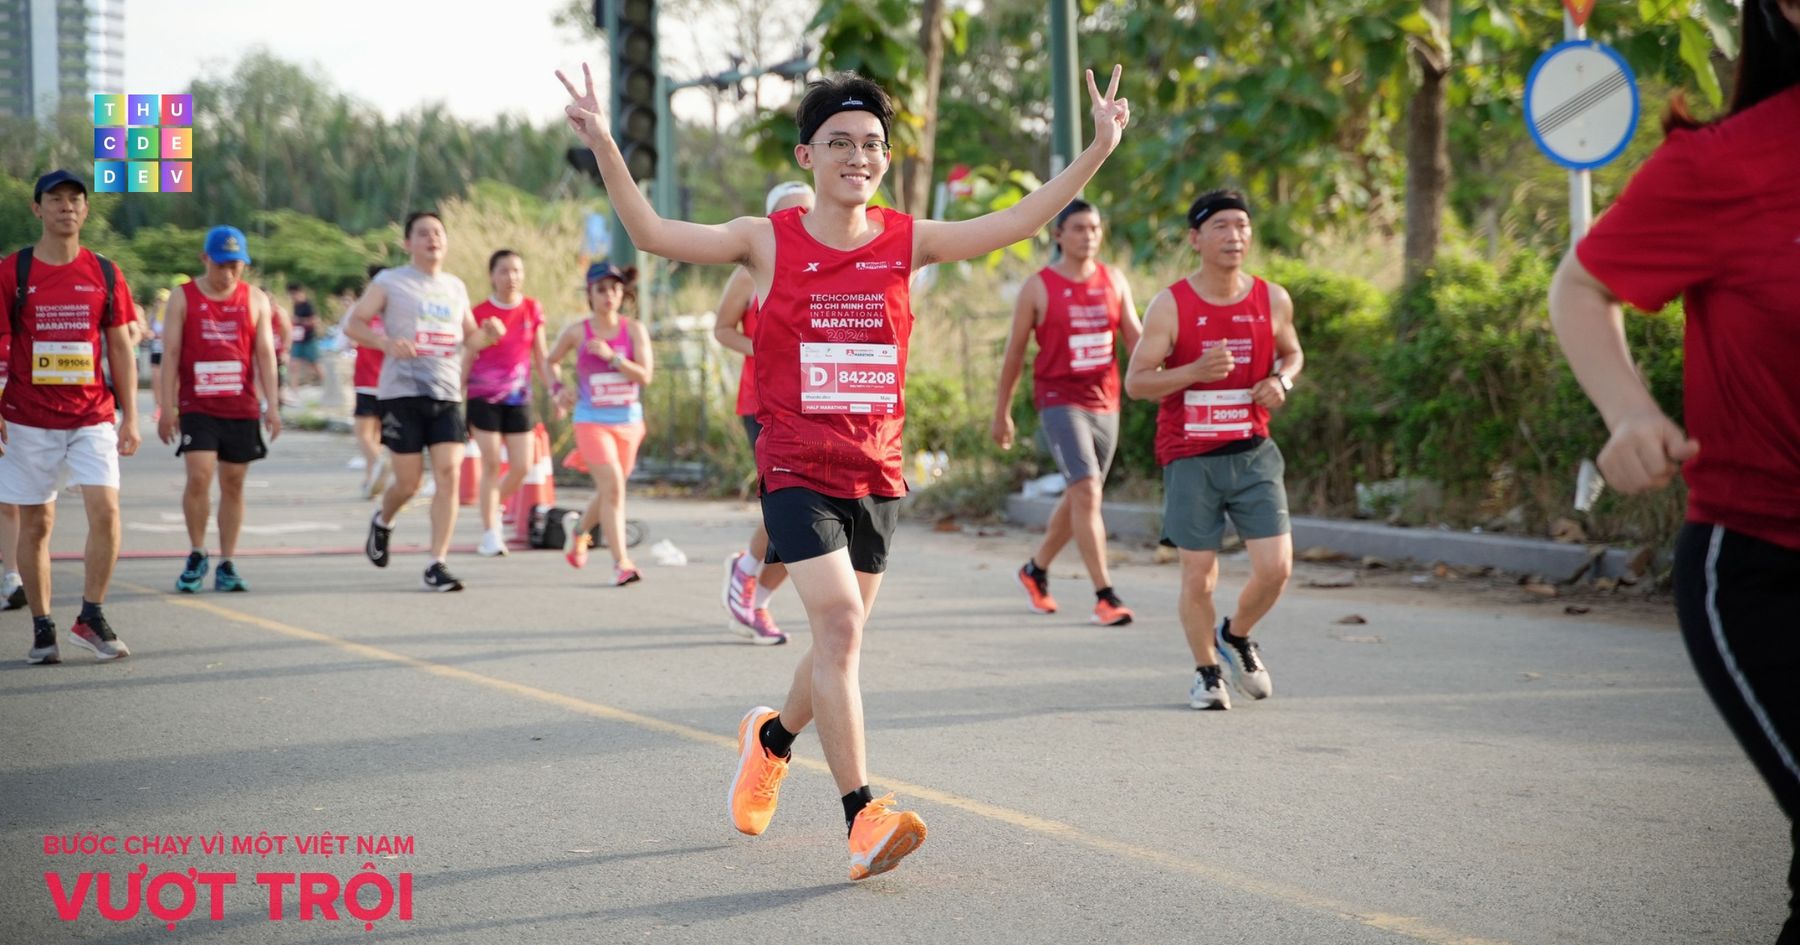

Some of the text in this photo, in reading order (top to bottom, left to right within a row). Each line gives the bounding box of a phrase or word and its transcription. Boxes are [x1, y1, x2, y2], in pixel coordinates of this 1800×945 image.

[810, 293, 884, 301] TECHCOMBANK
[35, 304, 90, 312] TECHCOMBANK
[36, 321, 90, 331] MARATHON
[811, 318, 883, 328] MARATHON
[826, 329, 868, 342] 2024
[39, 357, 49, 368] D
[809, 367, 896, 386] D 842208
